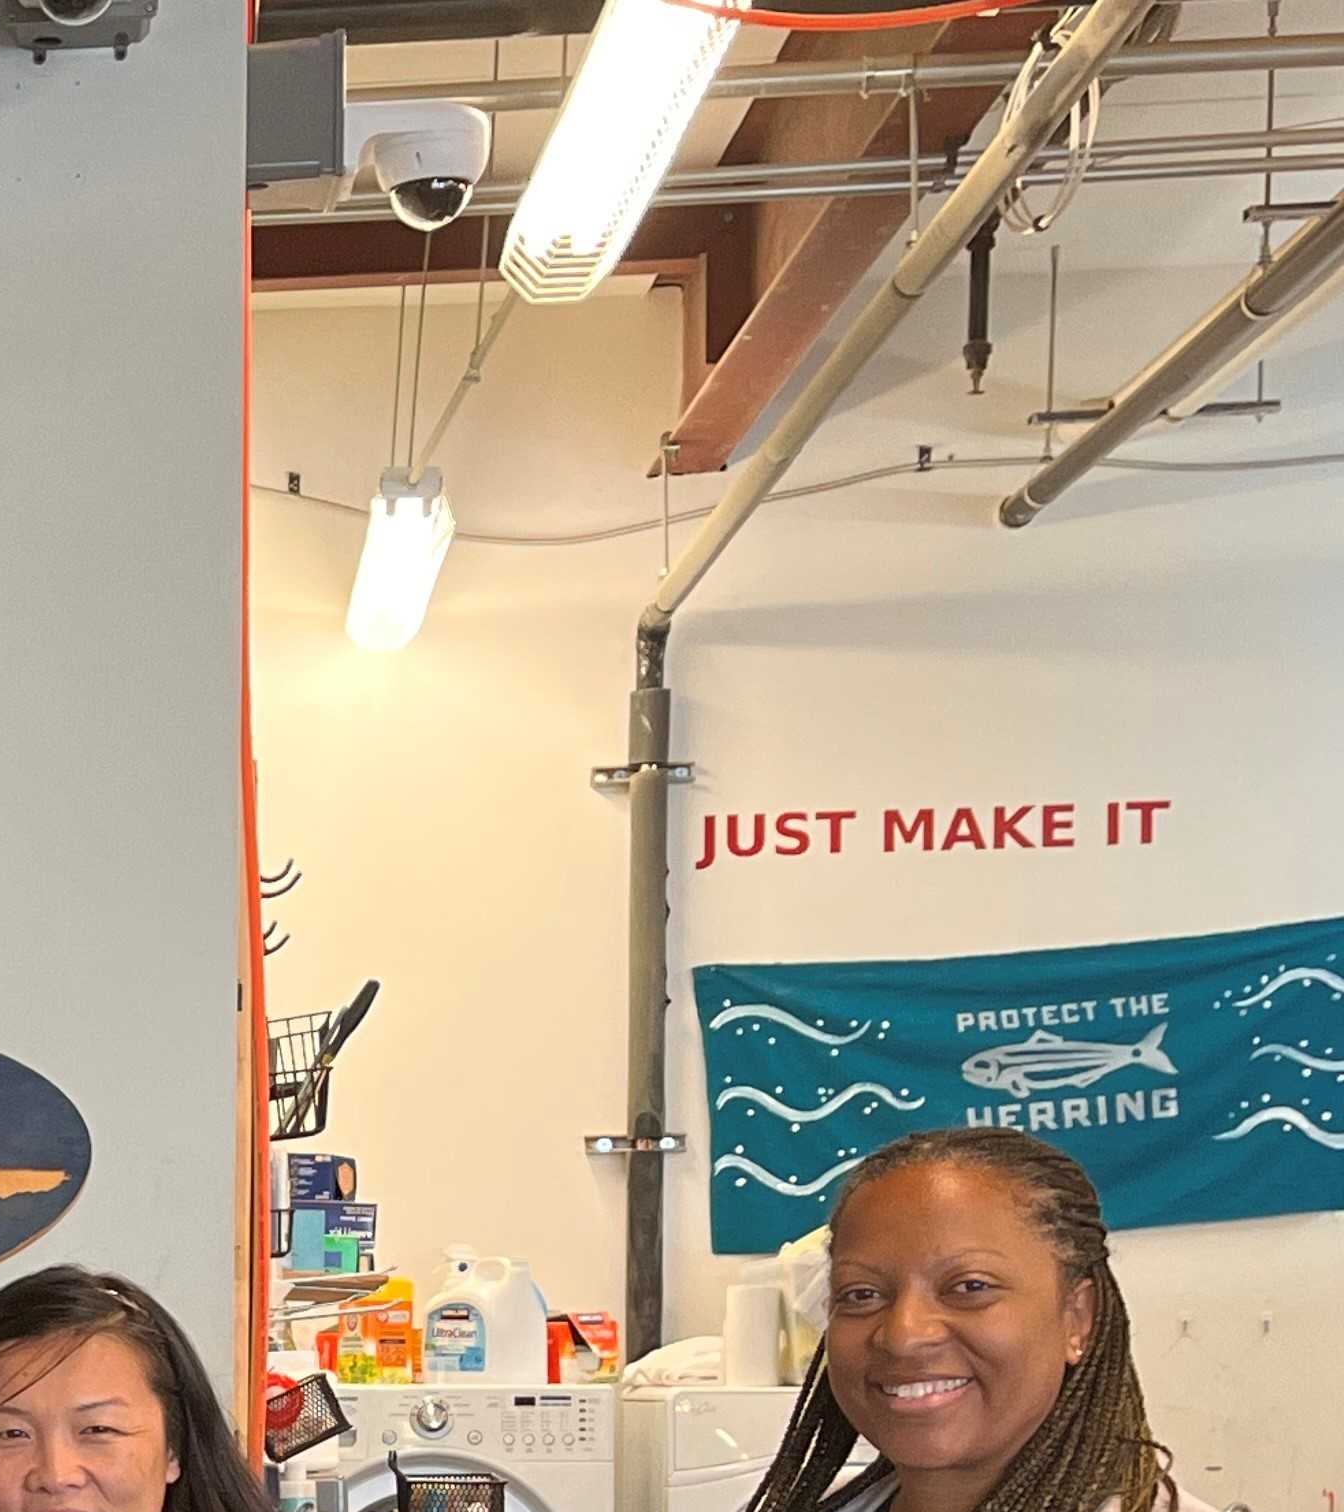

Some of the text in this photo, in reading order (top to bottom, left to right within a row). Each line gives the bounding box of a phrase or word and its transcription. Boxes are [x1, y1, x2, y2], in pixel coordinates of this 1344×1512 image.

[695, 800, 1171, 870] JUST MAKE IT
[955, 992, 1170, 1034] PROTECT THE
[965, 1087, 1180, 1132] HERRING
